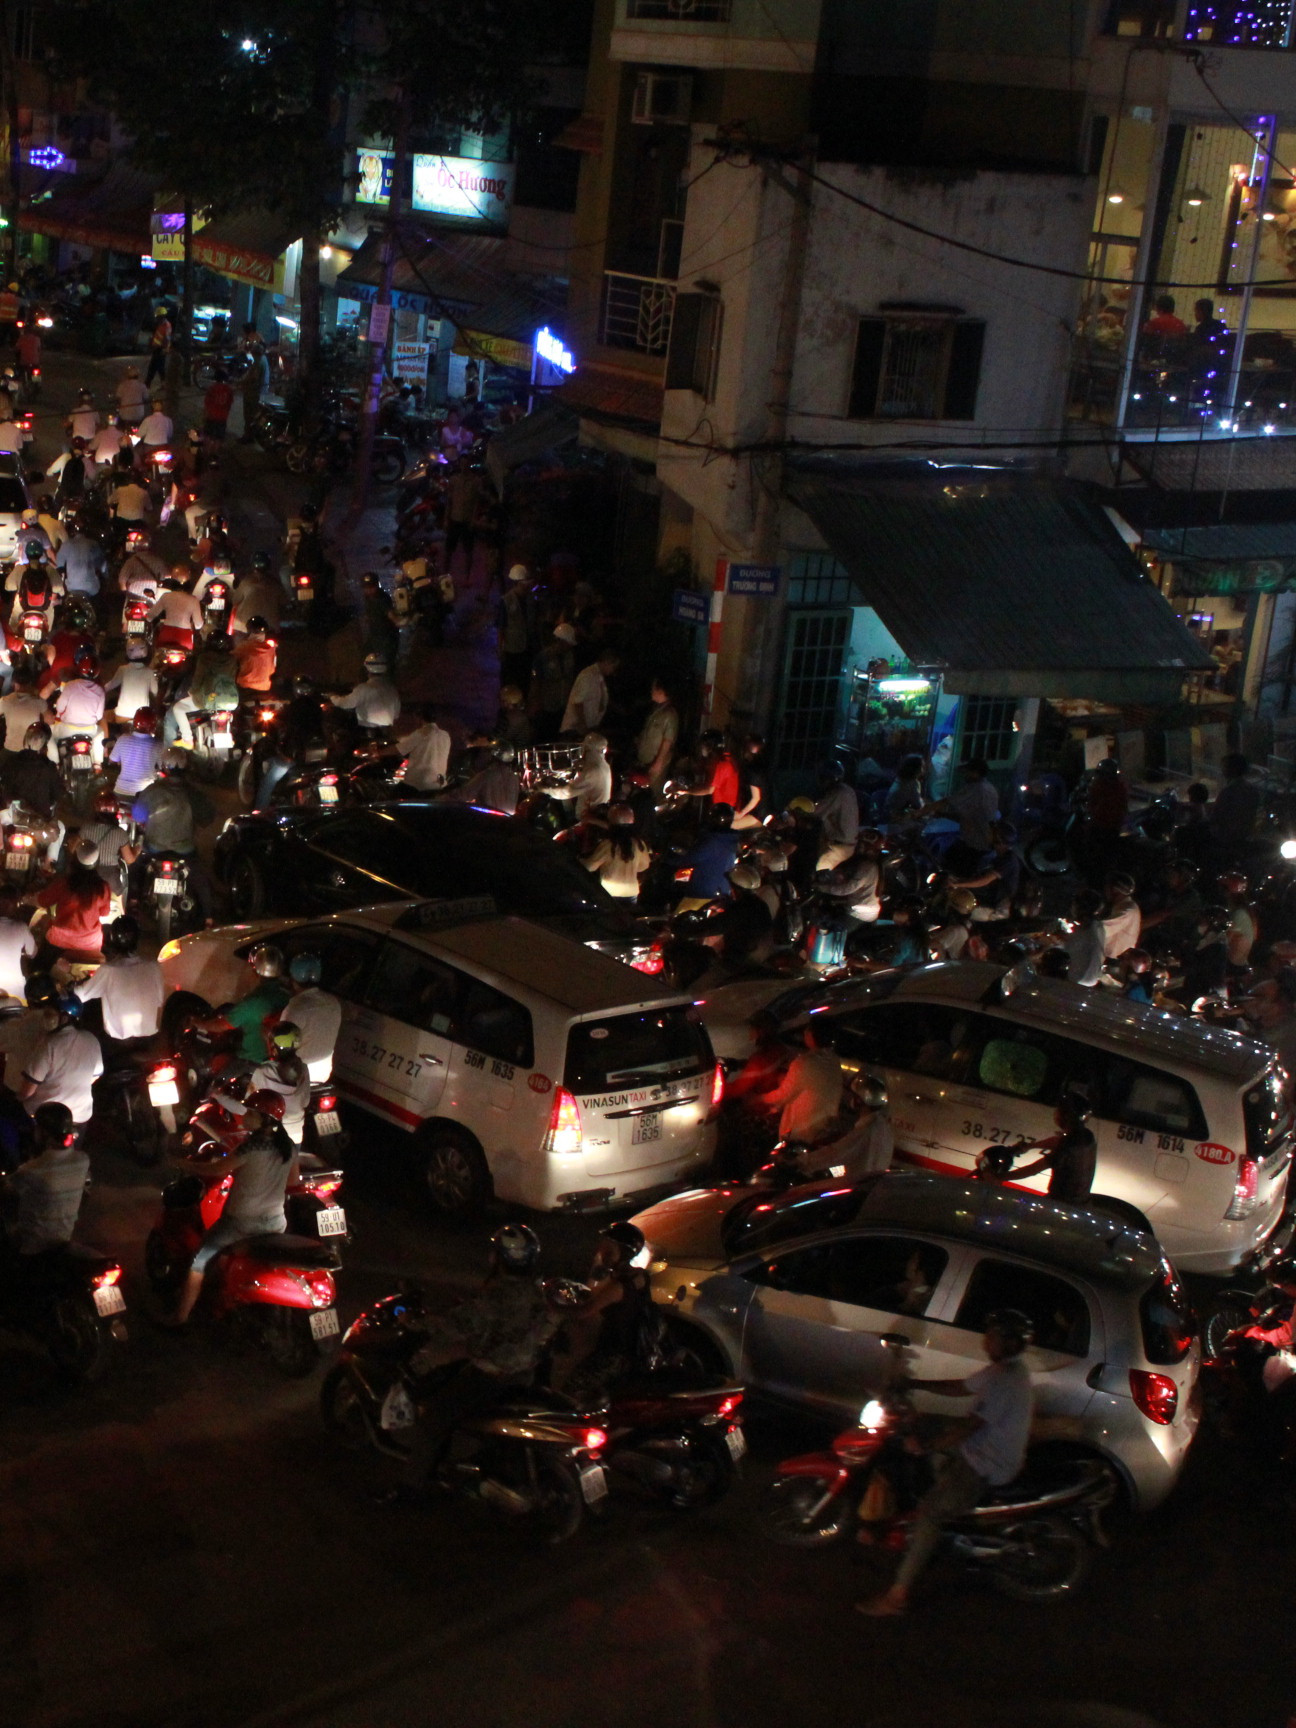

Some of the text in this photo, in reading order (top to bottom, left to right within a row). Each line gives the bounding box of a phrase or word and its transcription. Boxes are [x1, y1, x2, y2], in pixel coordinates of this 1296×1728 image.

[353, 1038, 422, 1078] 38.27 27 27
[464, 1050, 515, 1081] 56M 1635
[961, 1120, 1011, 1145] 38.27
[1116, 1125, 1185, 1154] 56M 1614
